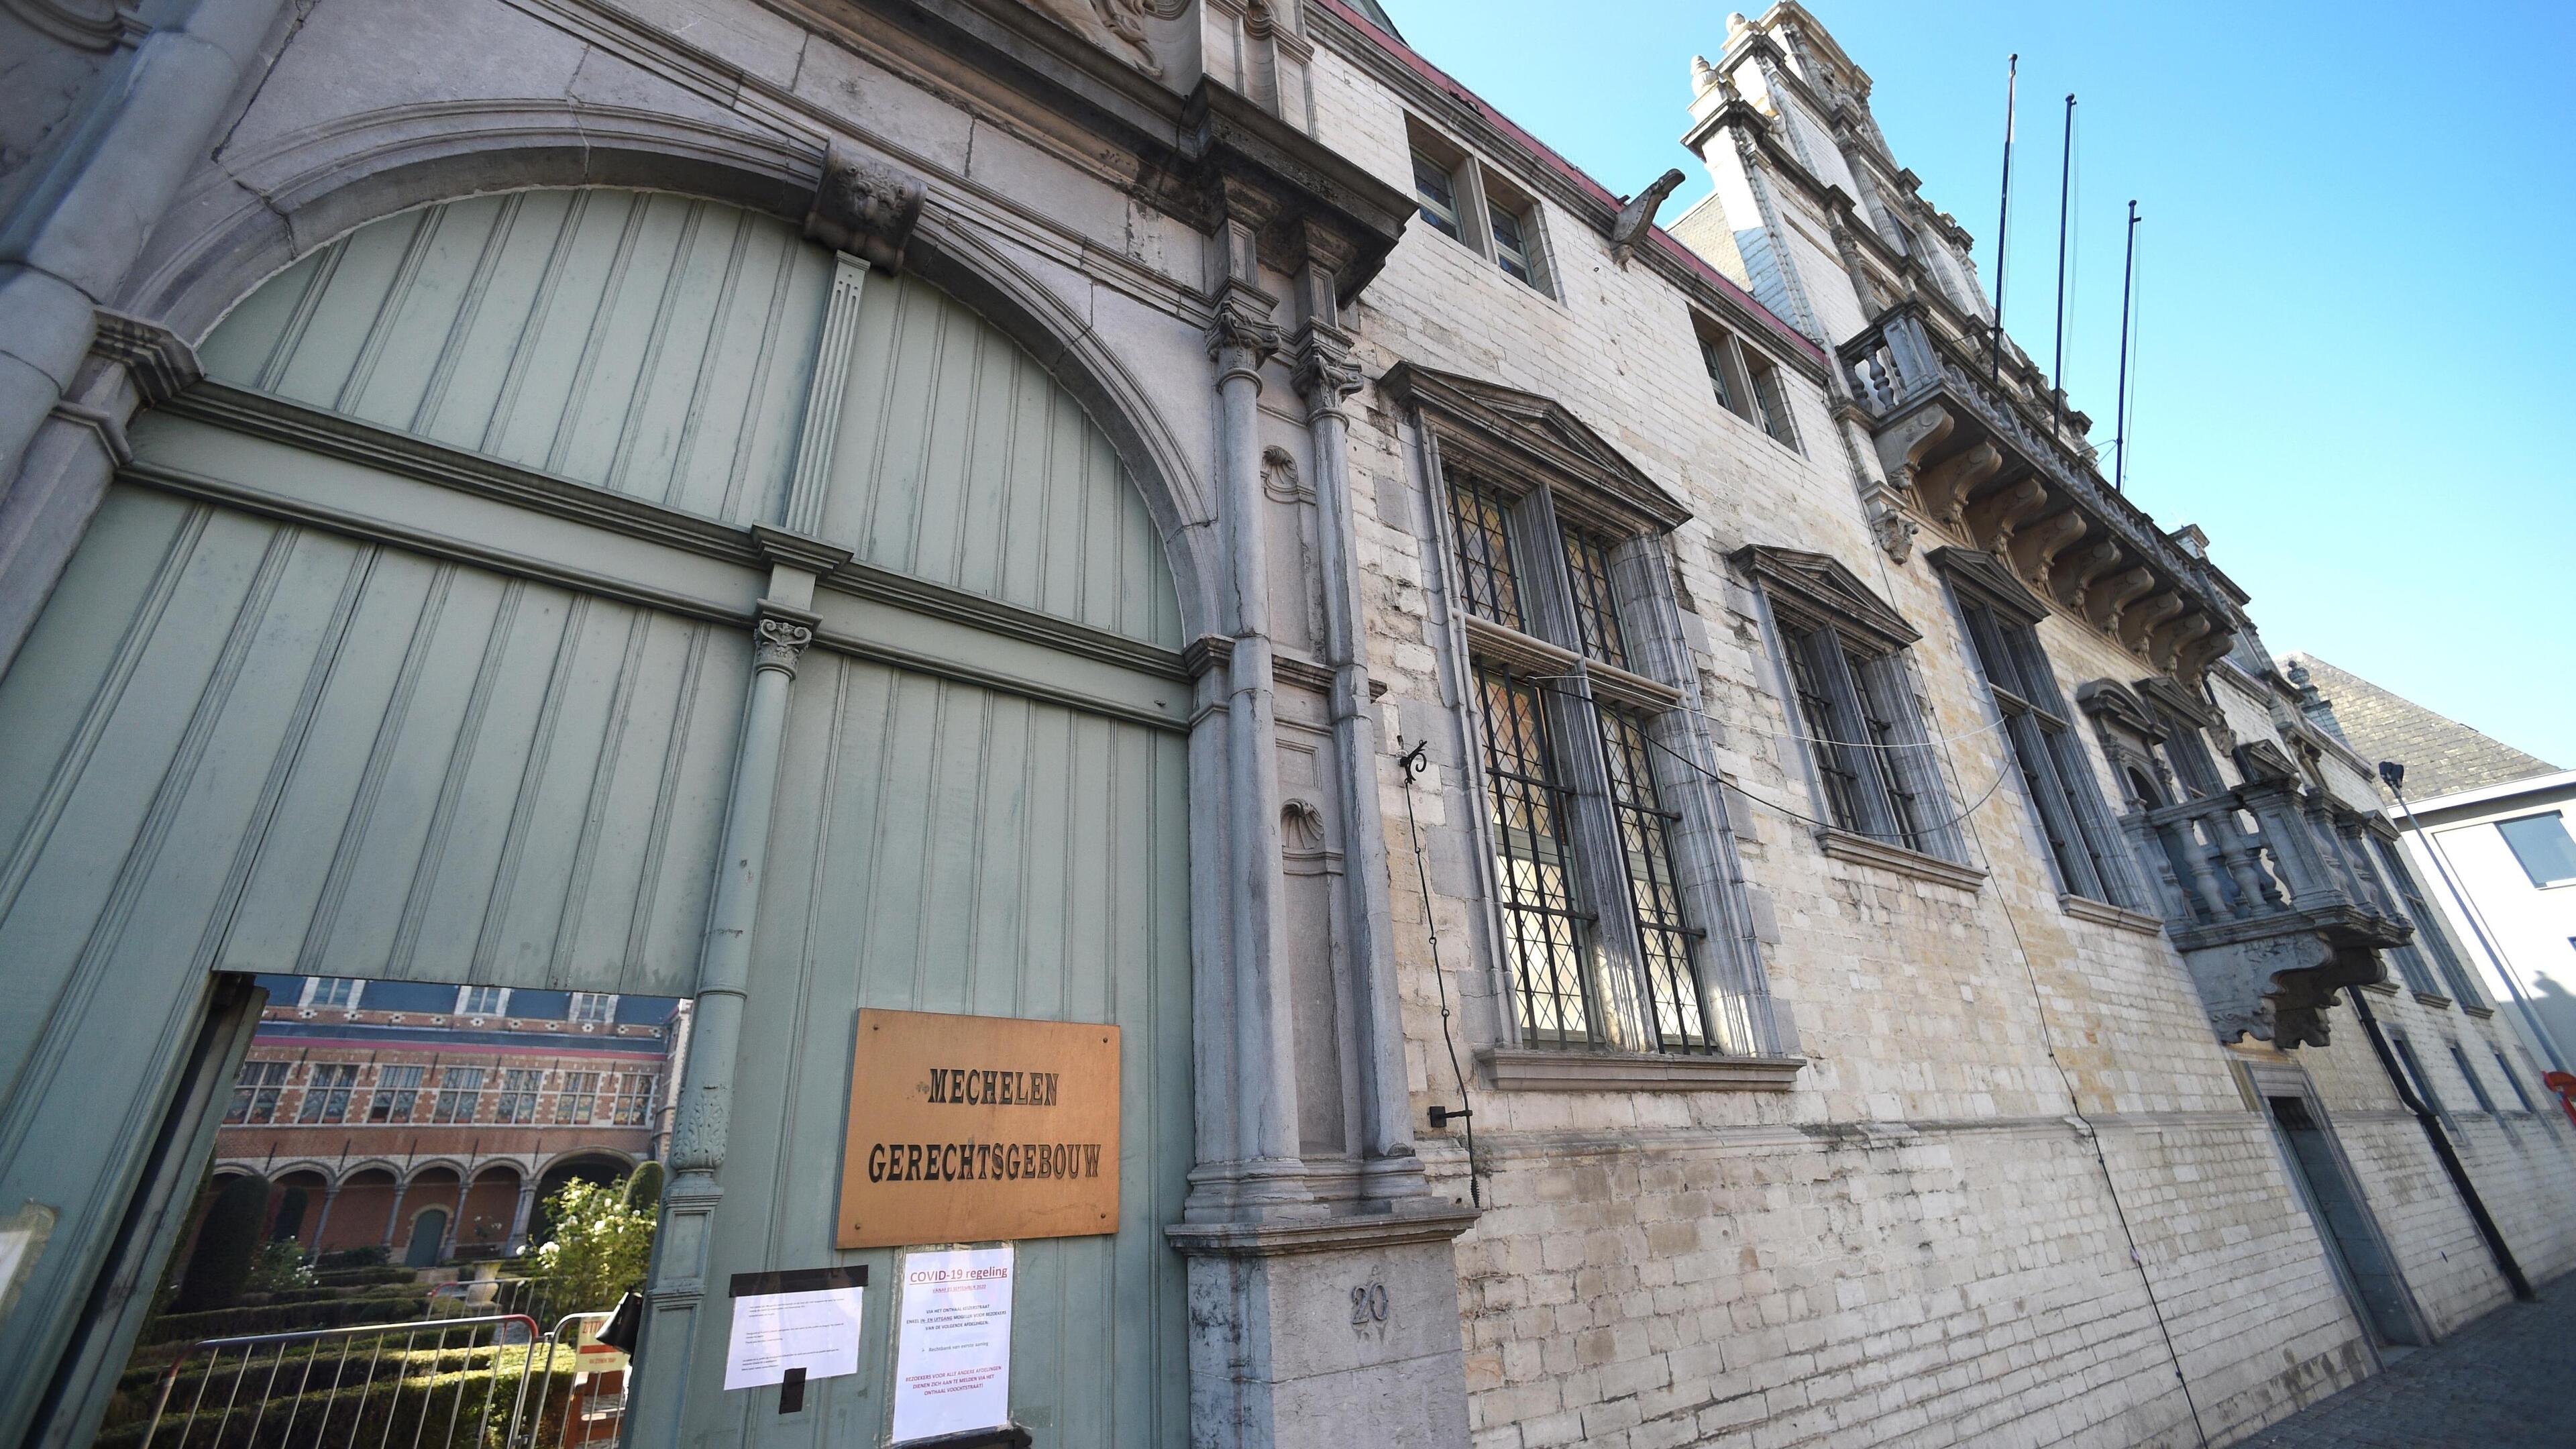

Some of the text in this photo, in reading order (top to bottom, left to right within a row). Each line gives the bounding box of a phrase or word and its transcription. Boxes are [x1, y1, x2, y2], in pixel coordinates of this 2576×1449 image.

[928, 1069, 1059, 1106] MECHELEN
[868, 1142, 1102, 1183] GERECHTSGEBOUW
[910, 1267, 1008, 1283] COVID-19 regeling
[1351, 1282, 1388, 1325] 20
[906, 1374, 931, 1382] BEZOEKERS
